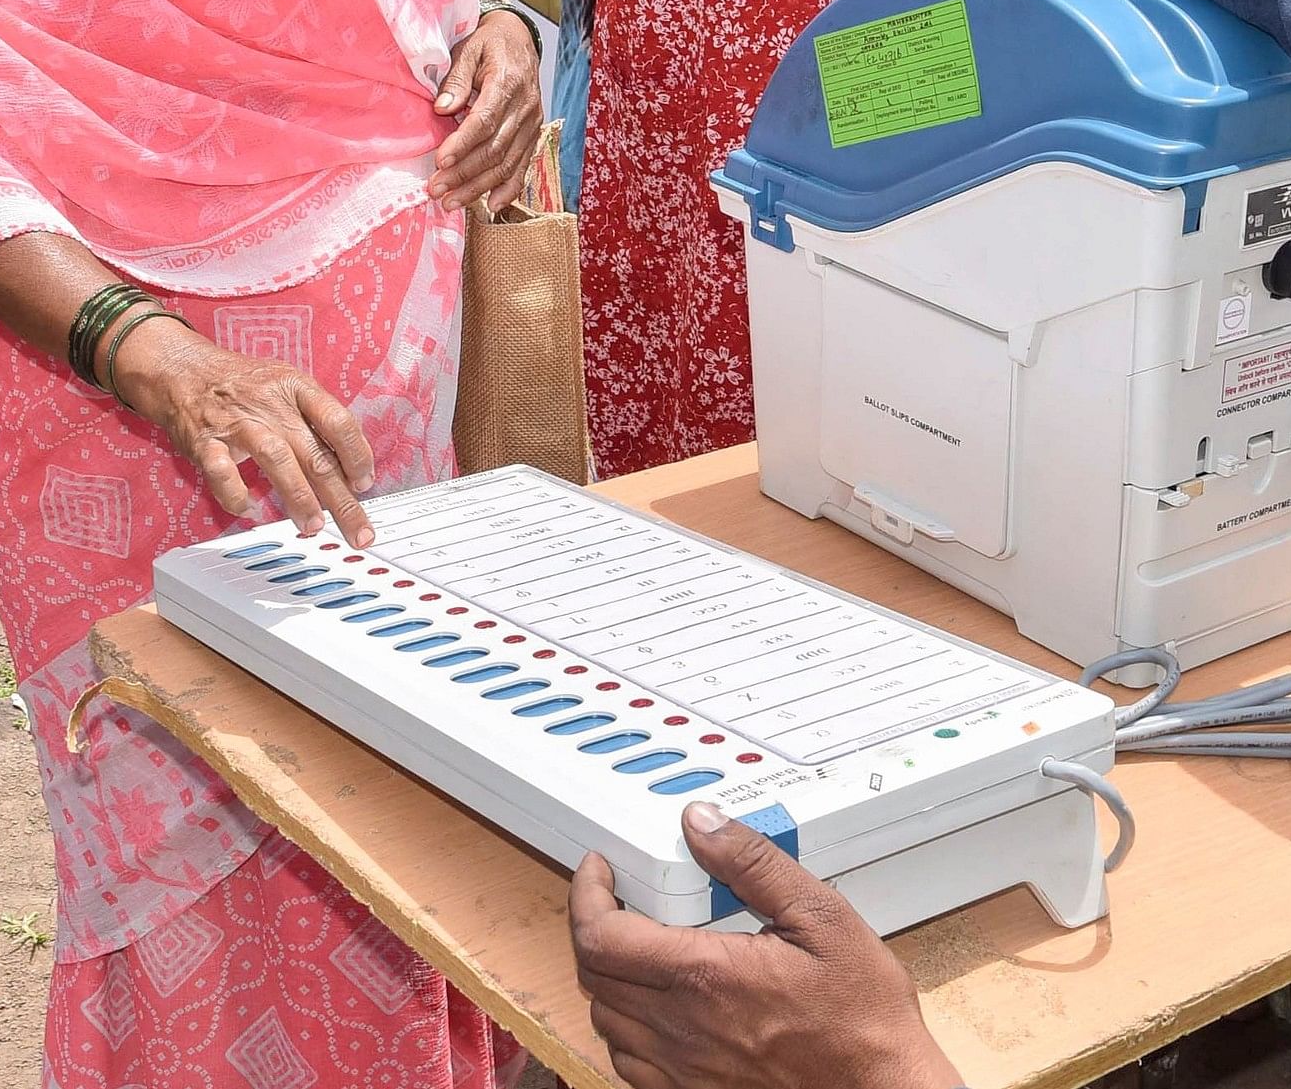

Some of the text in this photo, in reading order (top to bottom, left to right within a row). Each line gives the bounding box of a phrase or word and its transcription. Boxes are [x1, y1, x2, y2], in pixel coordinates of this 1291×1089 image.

[1216, 399, 1260, 418] CONNECTOR
[864, 395, 962, 447] BALLOT SLIPS COMPARTMENT
[1216, 514, 1248, 532] BATTERY
[568, 551, 605, 564] KKK
[795, 647, 831, 662] DDD
[716, 767, 799, 799] Ballot Unit
